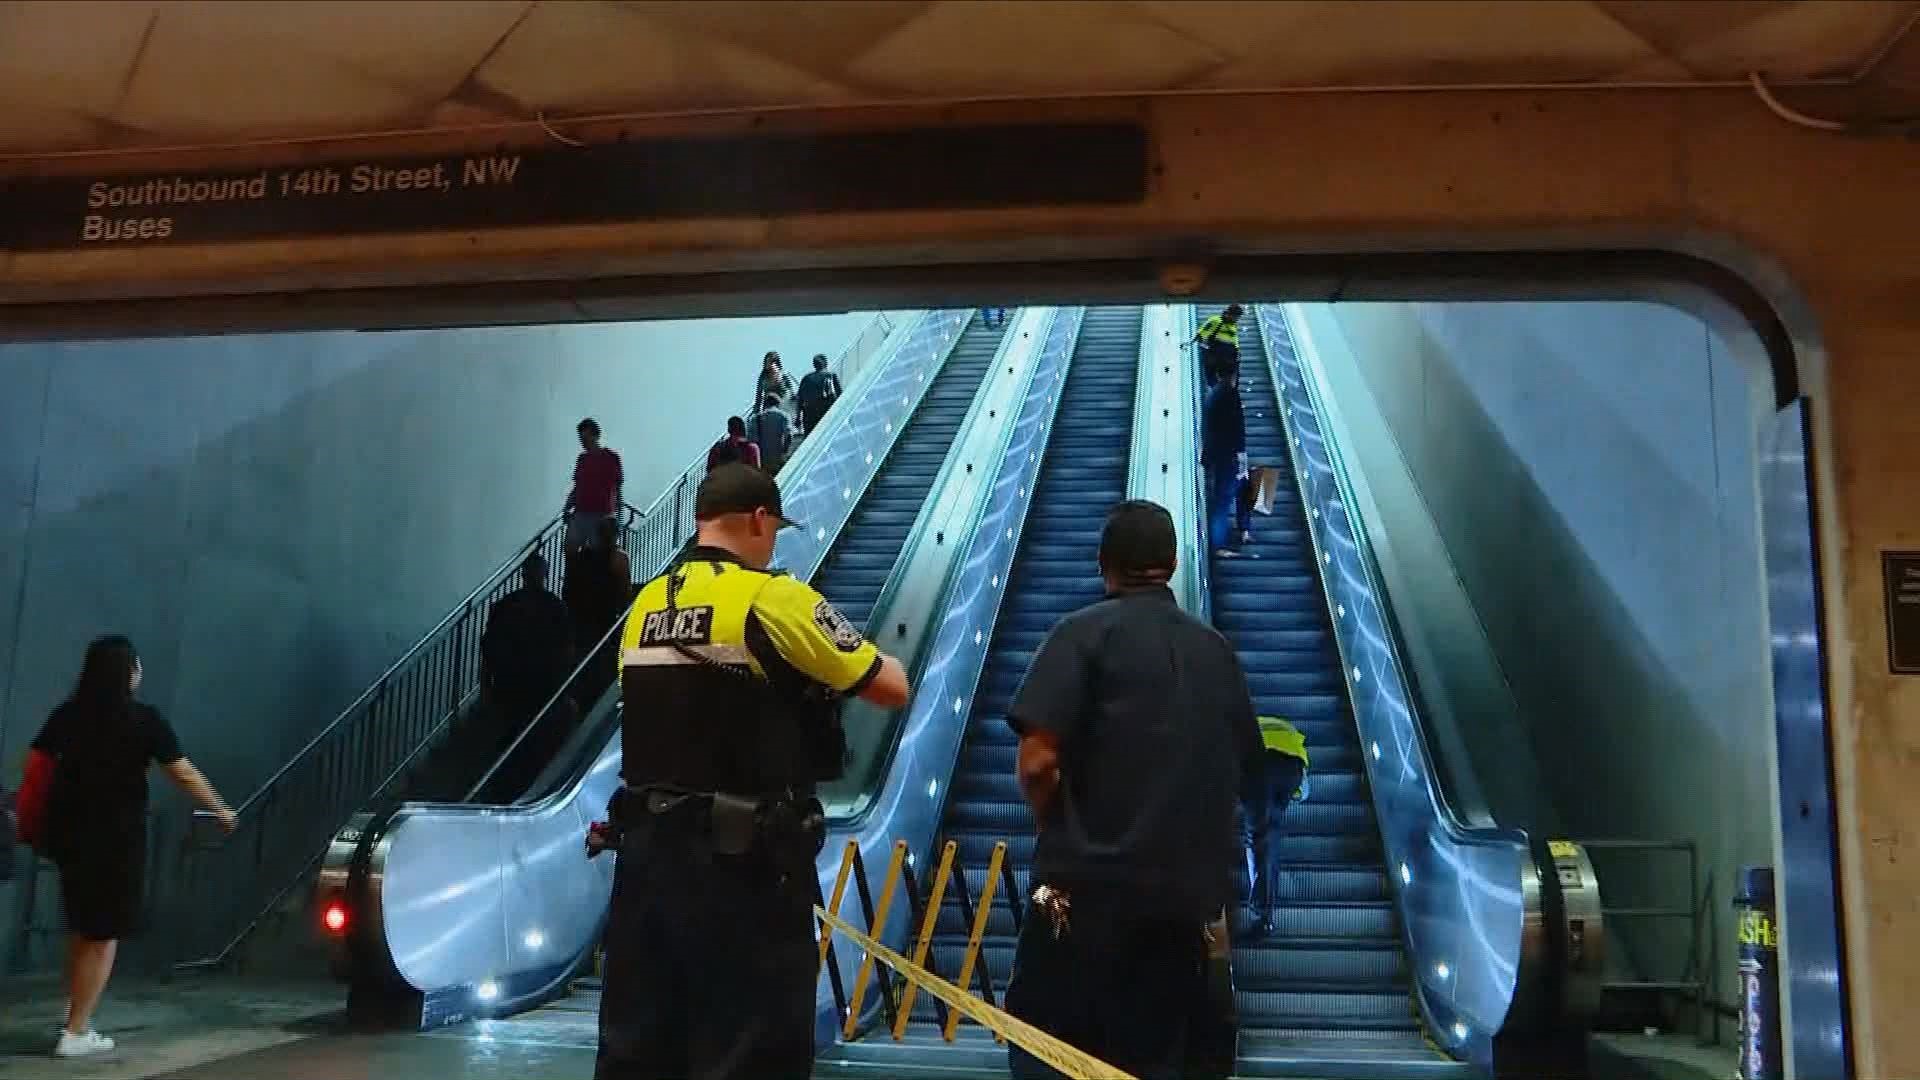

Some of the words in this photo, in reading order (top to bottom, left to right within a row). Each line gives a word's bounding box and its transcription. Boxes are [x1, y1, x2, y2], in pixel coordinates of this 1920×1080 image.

[87, 171, 267, 208] Southbound
[278, 168, 342, 198] 14th
[351, 161, 450, 194] Street,
[463, 155, 521, 186] NW
[82, 214, 174, 241] Buses
[642, 608, 706, 643] POLICE
